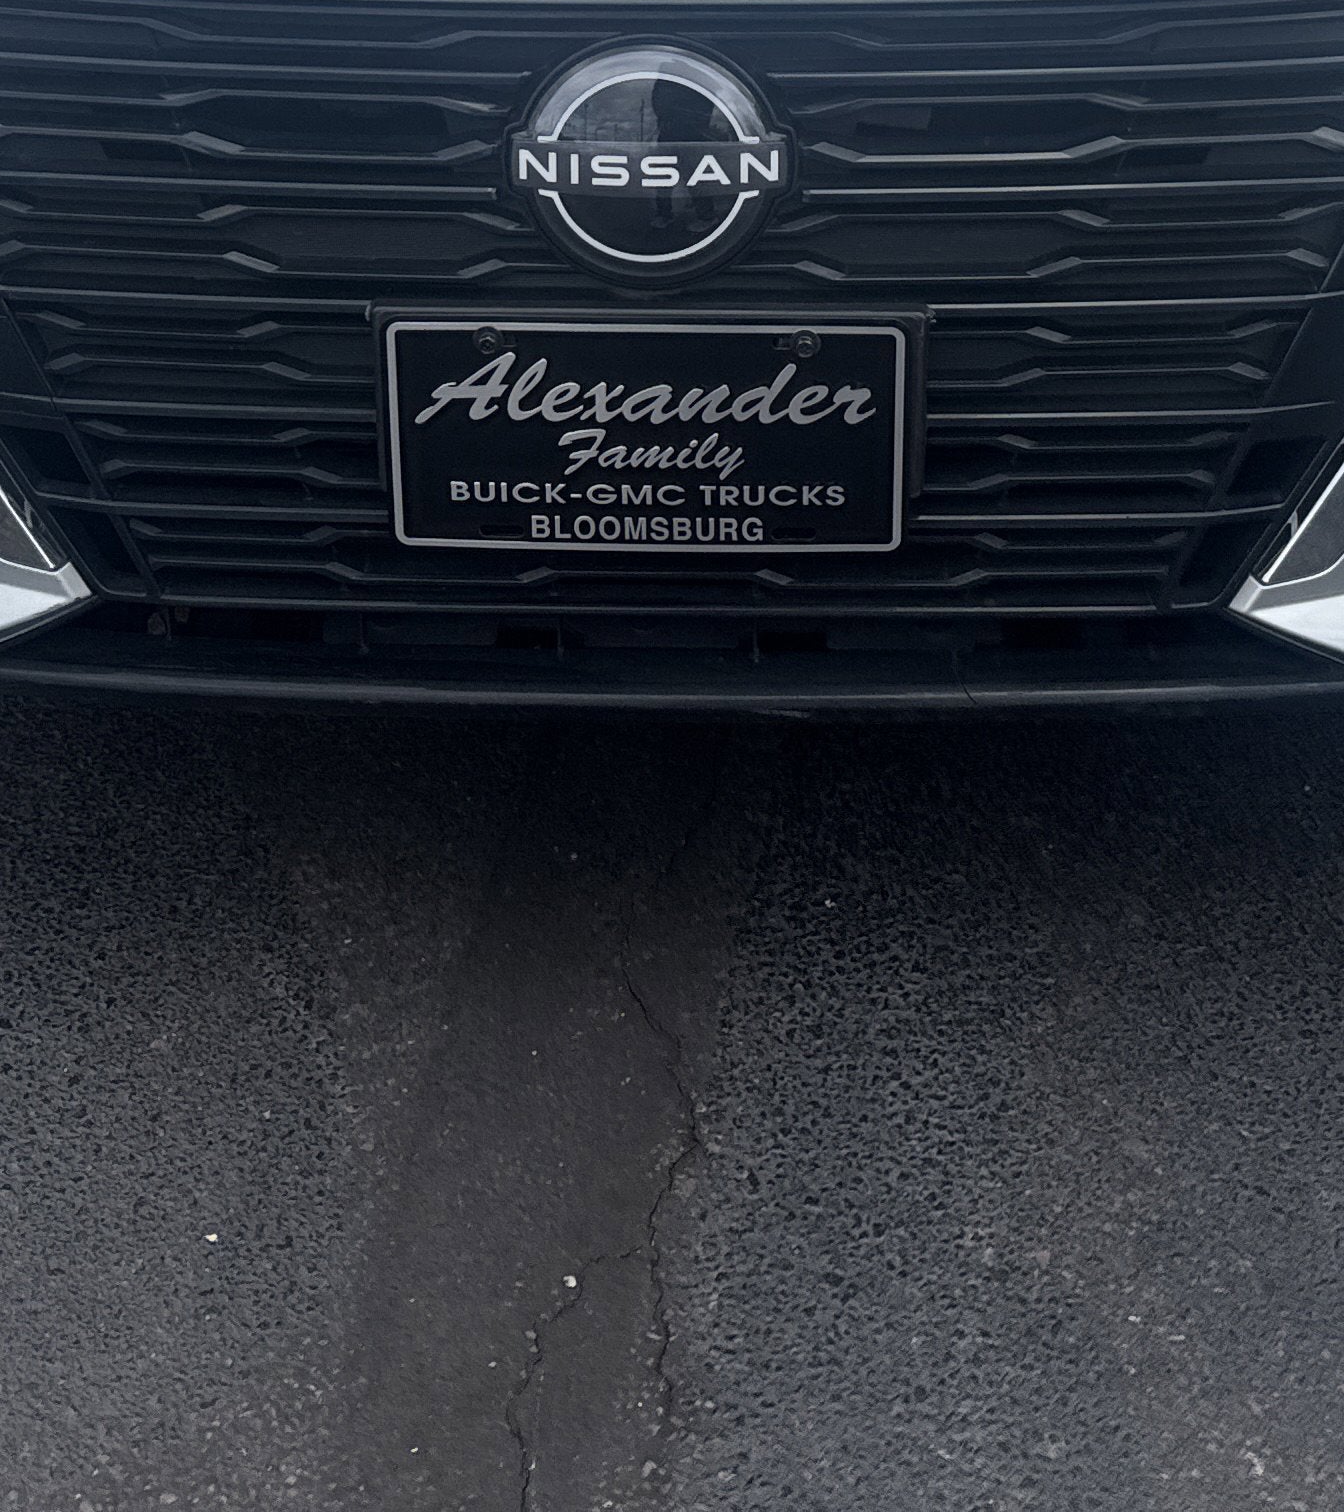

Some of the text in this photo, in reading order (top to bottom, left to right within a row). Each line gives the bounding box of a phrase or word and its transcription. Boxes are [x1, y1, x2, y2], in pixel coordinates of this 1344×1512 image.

[518, 149, 779, 187] NISSAN
[414, 352, 877, 425] Alexander
[558, 428, 745, 480] Family
[450, 481, 845, 507] BUICK-GMC TRUCKS
[531, 514, 764, 541] BLOOMSBURG
